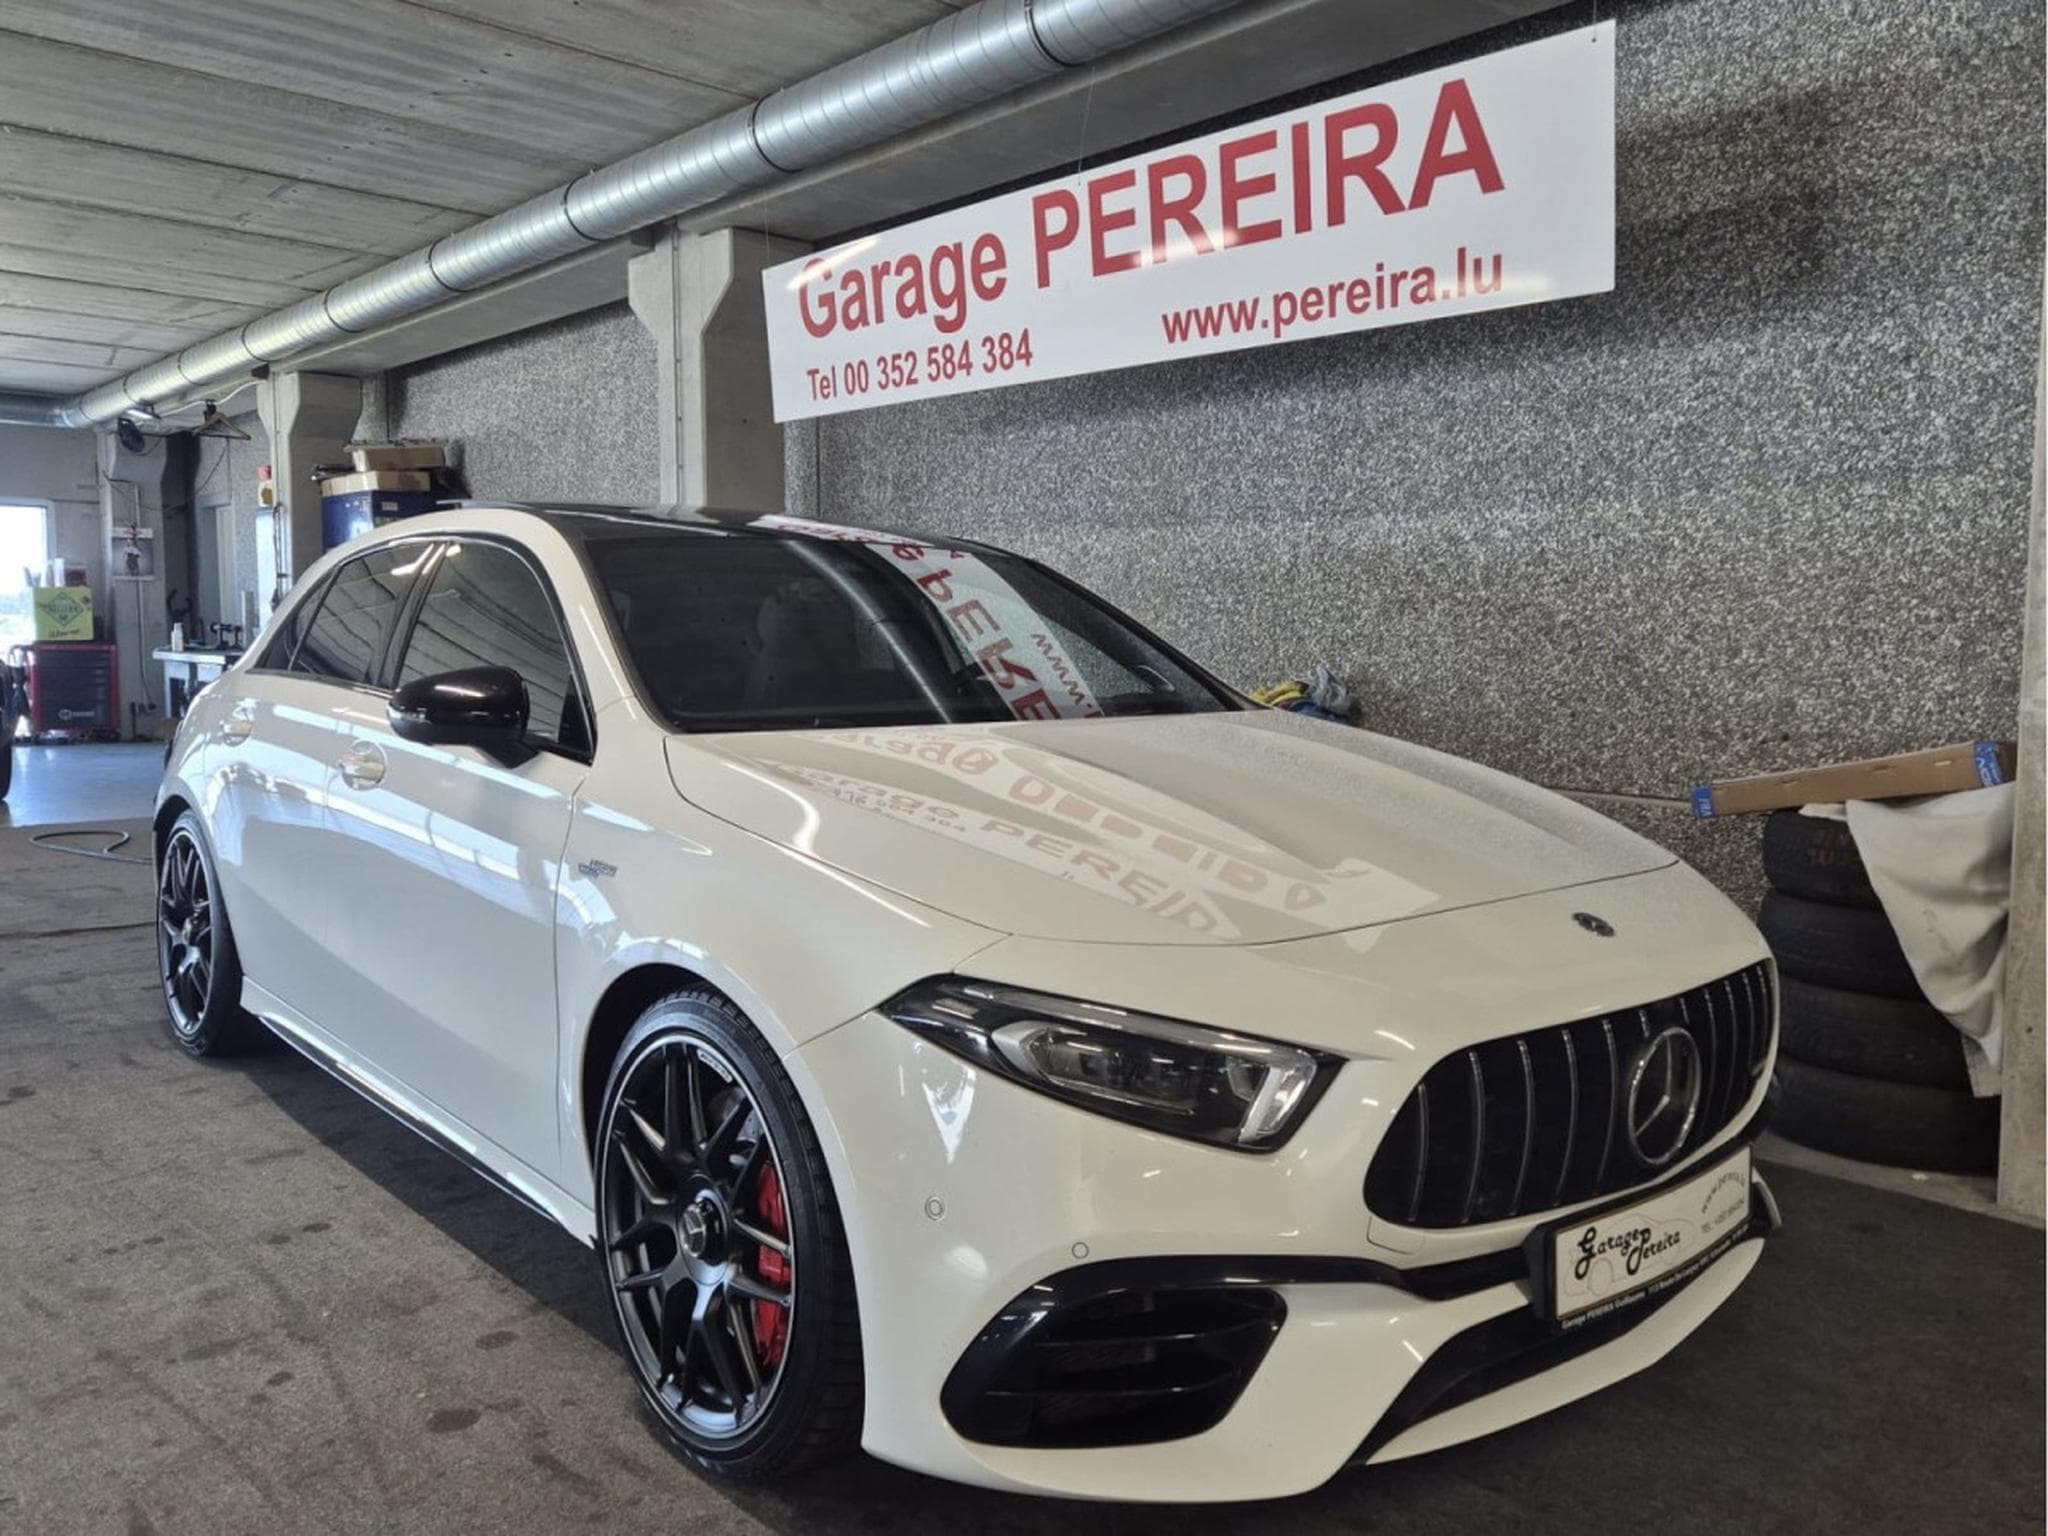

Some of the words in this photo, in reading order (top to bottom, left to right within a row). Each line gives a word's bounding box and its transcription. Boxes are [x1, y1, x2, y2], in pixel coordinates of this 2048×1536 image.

[799, 232, 1007, 339] Garage
[1032, 78, 1506, 289] PEREIRA
[1161, 246, 1502, 344] www.pereira.lu
[807, 365, 838, 401] Tel
[844, 359, 869, 396] 00
[876, 350, 919, 391] 352
[927, 339, 973, 383] 584
[981, 328, 1033, 374] 384
[1574, 1226, 1639, 1280] Garage
[1626, 1227, 1680, 1275] Pereira
